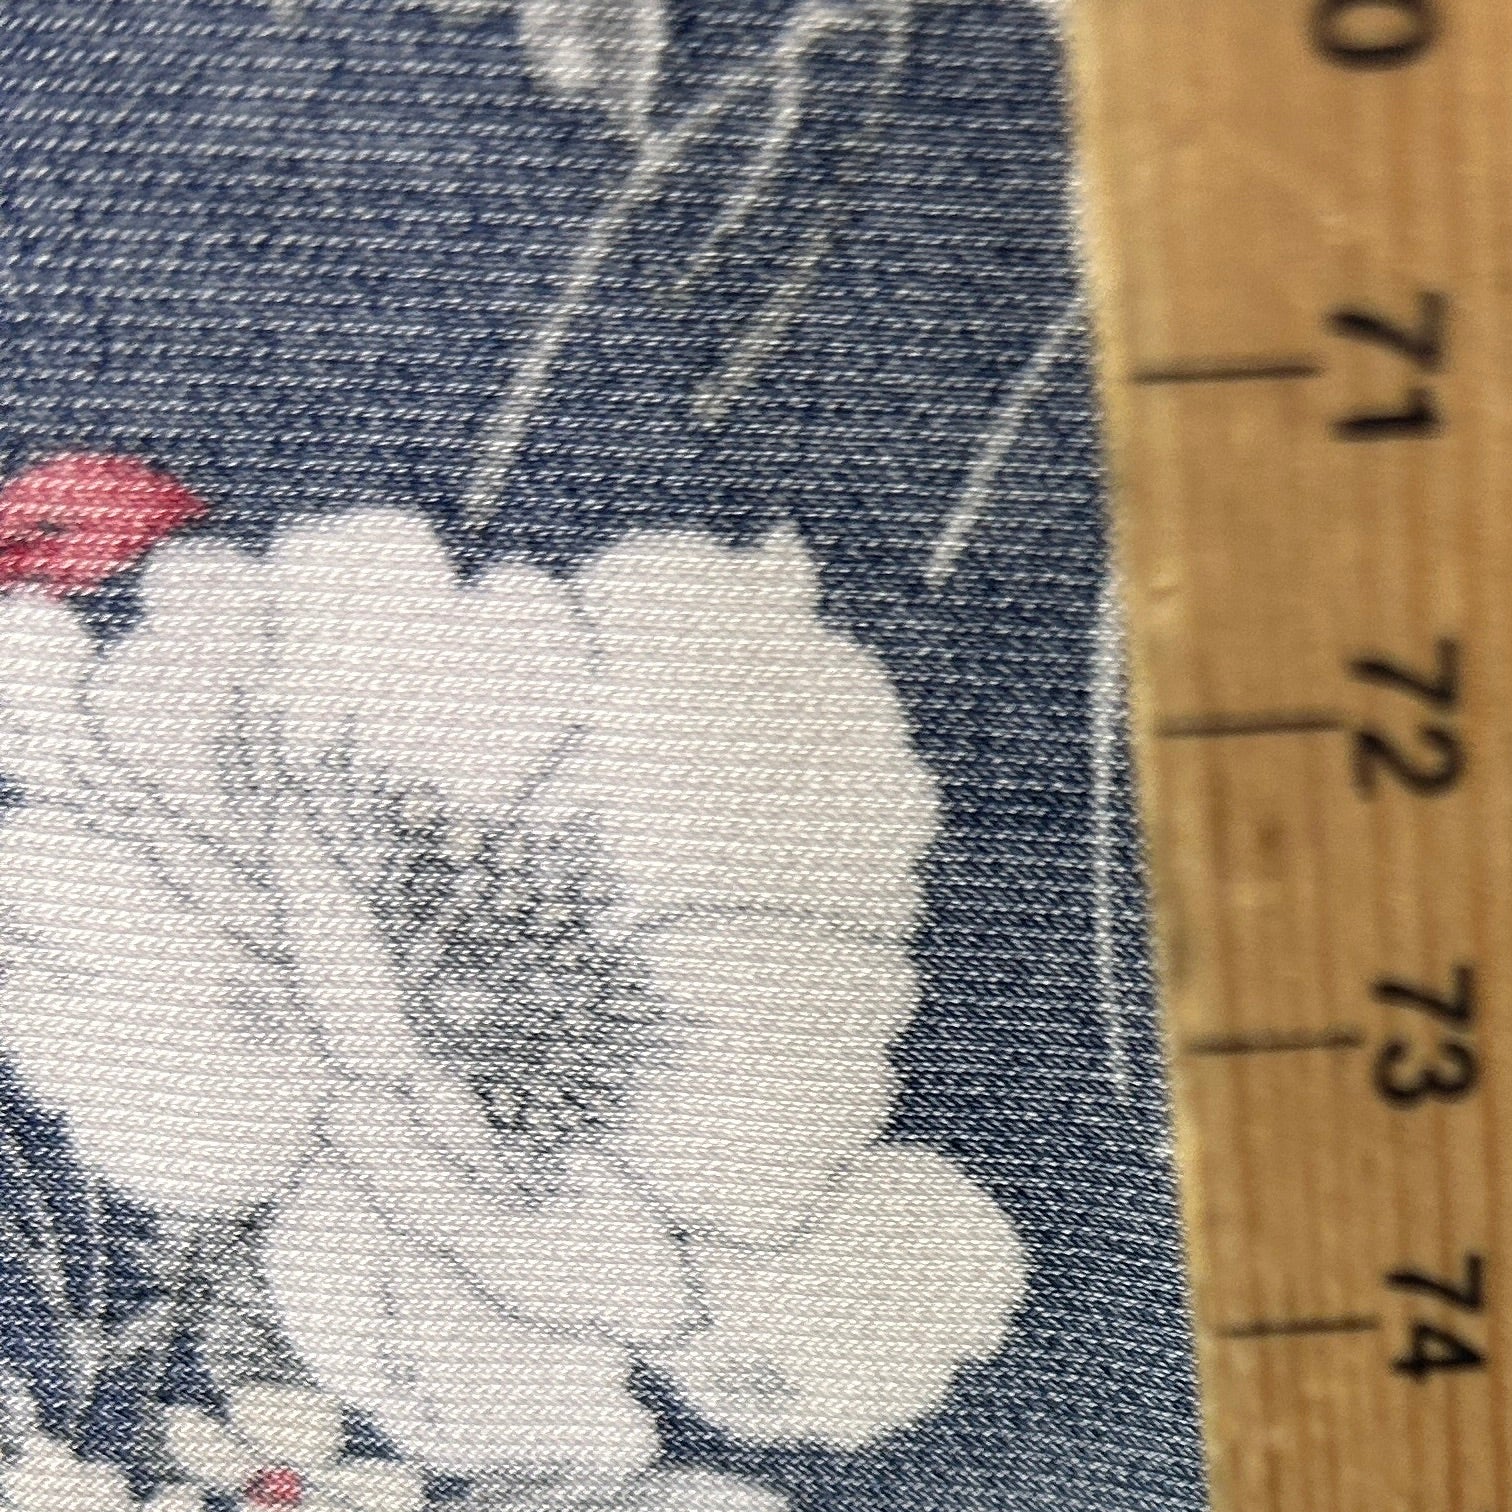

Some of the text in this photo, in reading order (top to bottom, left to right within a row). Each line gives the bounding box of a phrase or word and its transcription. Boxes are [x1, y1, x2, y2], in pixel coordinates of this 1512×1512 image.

[1322, 289, 1450, 444] 71
[1345, 633, 1469, 799] 72
[1367, 960, 1489, 1111] 73
[1380, 1250, 1494, 1386] 74
